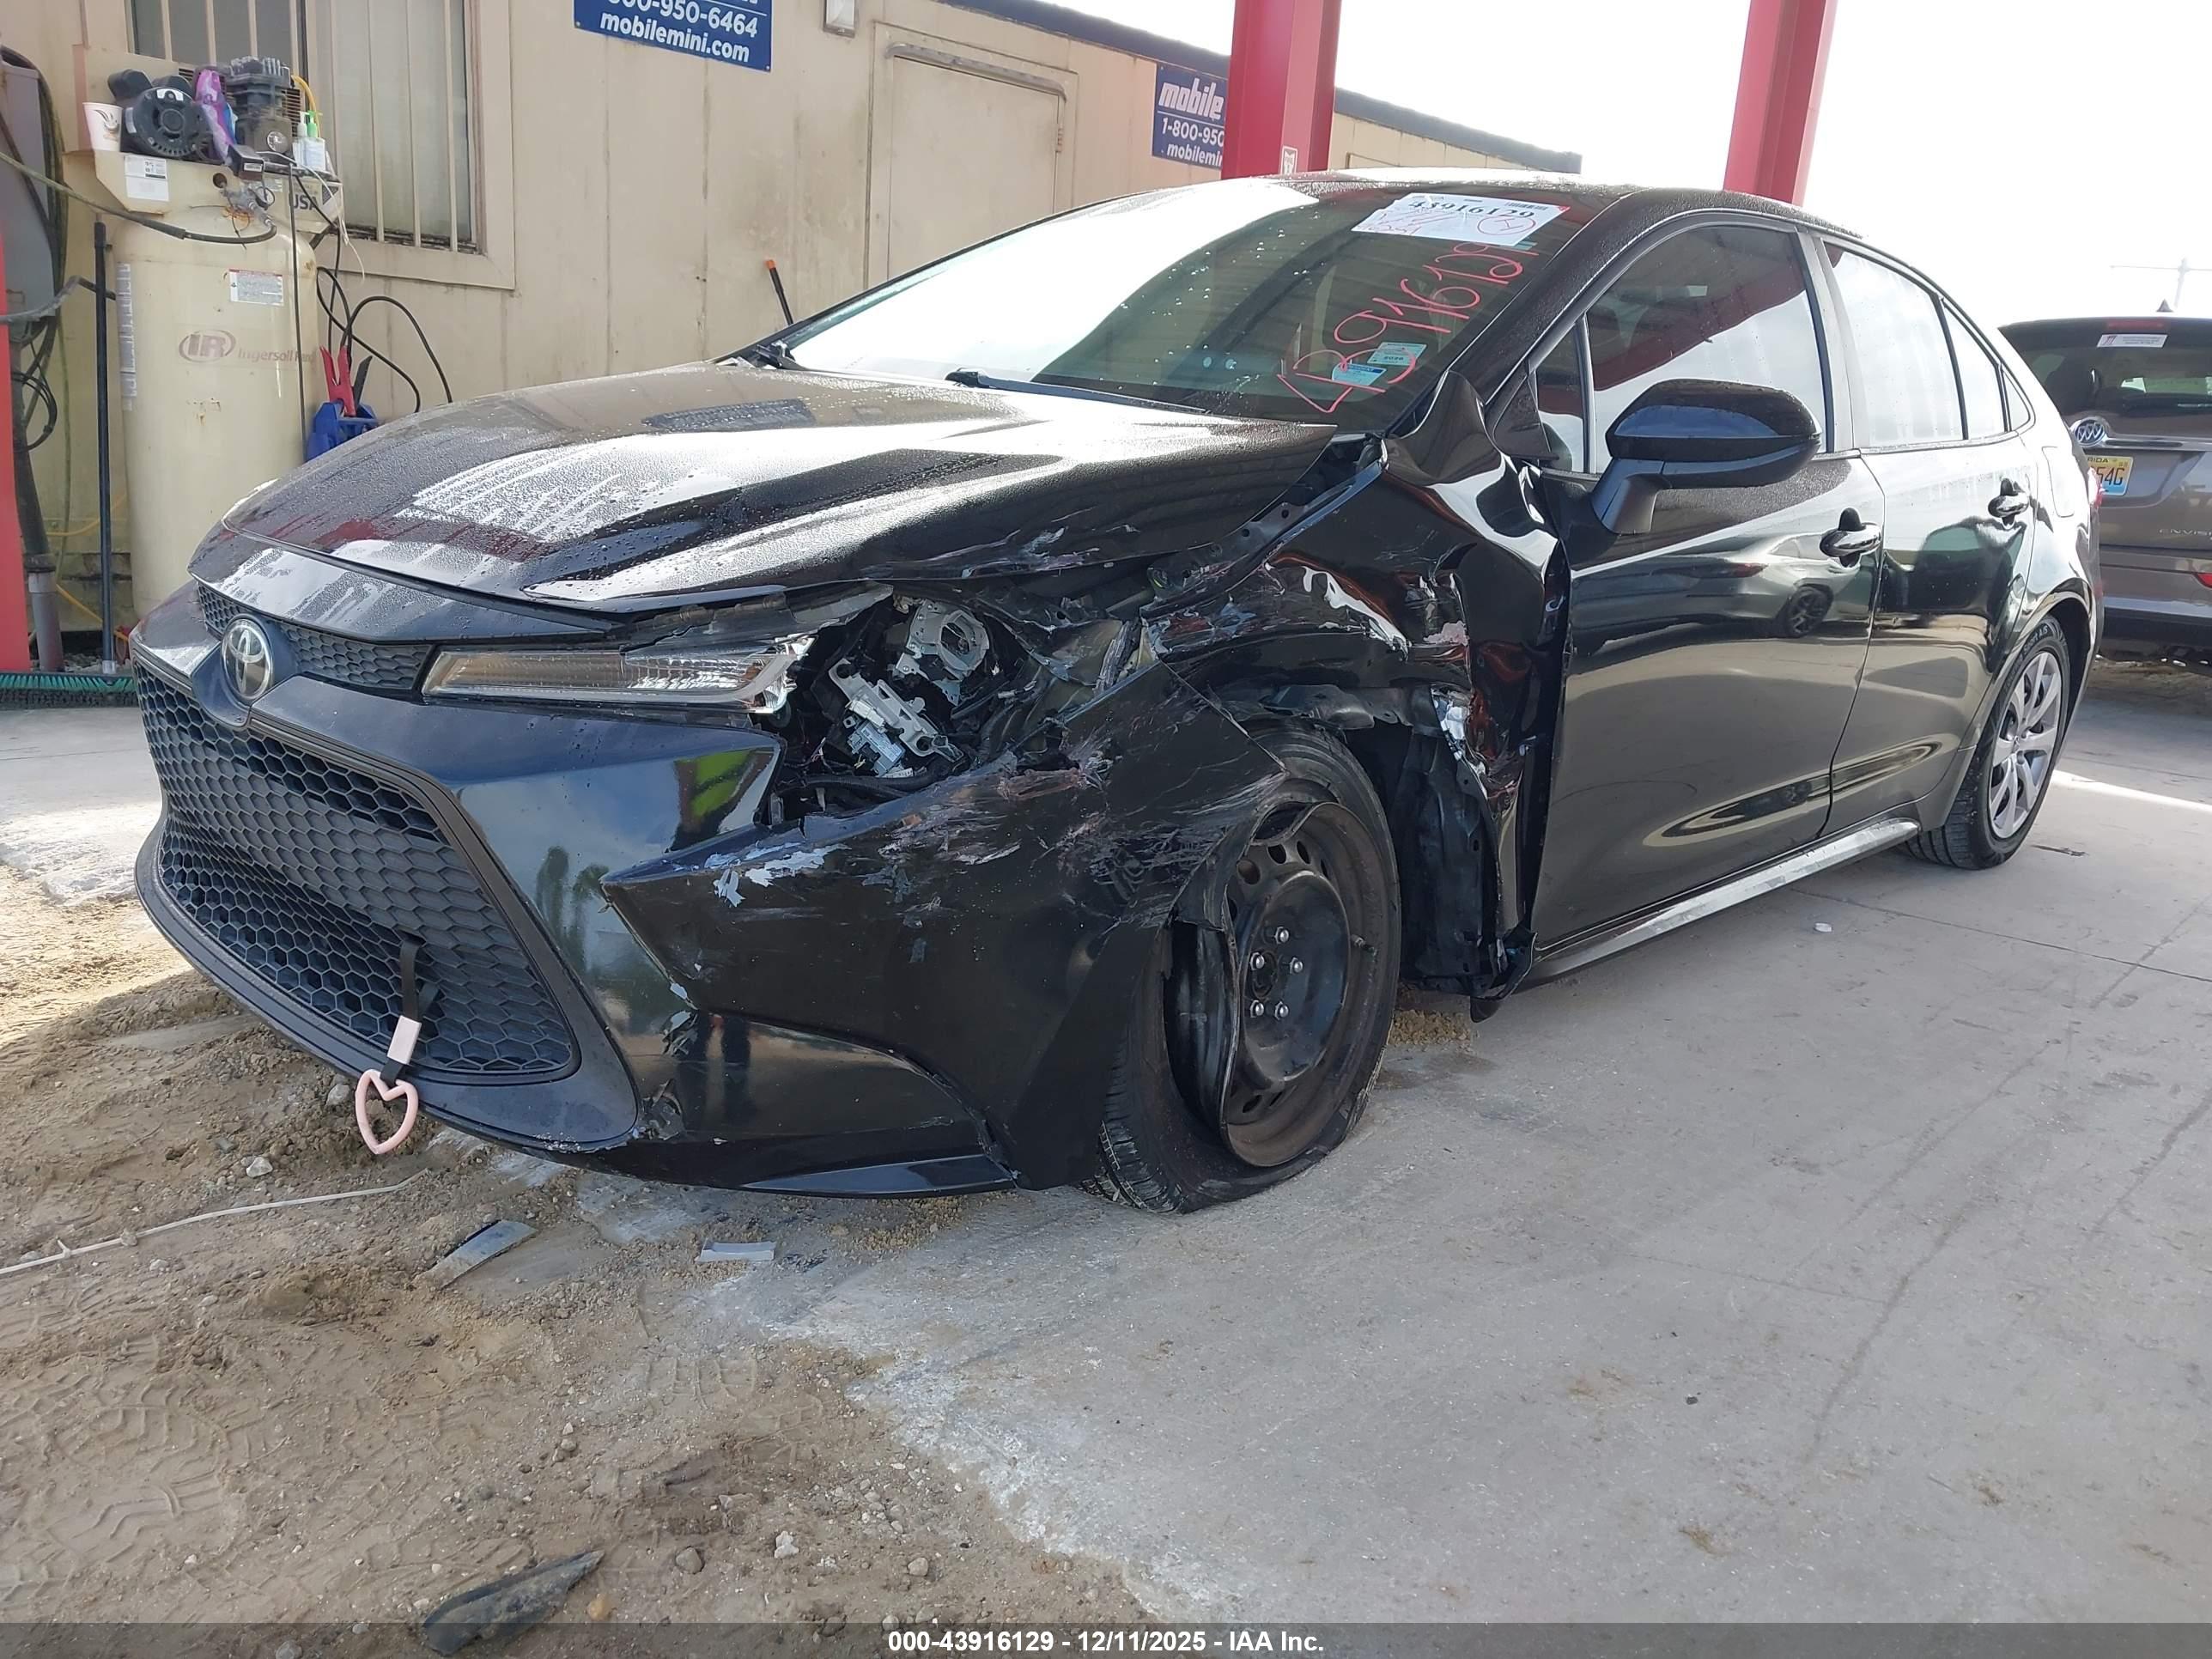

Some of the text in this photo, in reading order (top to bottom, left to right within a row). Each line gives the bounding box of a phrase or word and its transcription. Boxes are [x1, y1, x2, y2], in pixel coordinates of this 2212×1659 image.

[600, 11, 750, 62] mobilemini.com
[1158, 77, 1224, 119] mobile
[1408, 200, 1534, 218] 43916129
[238, 348, 294, 362] Ingersoll
